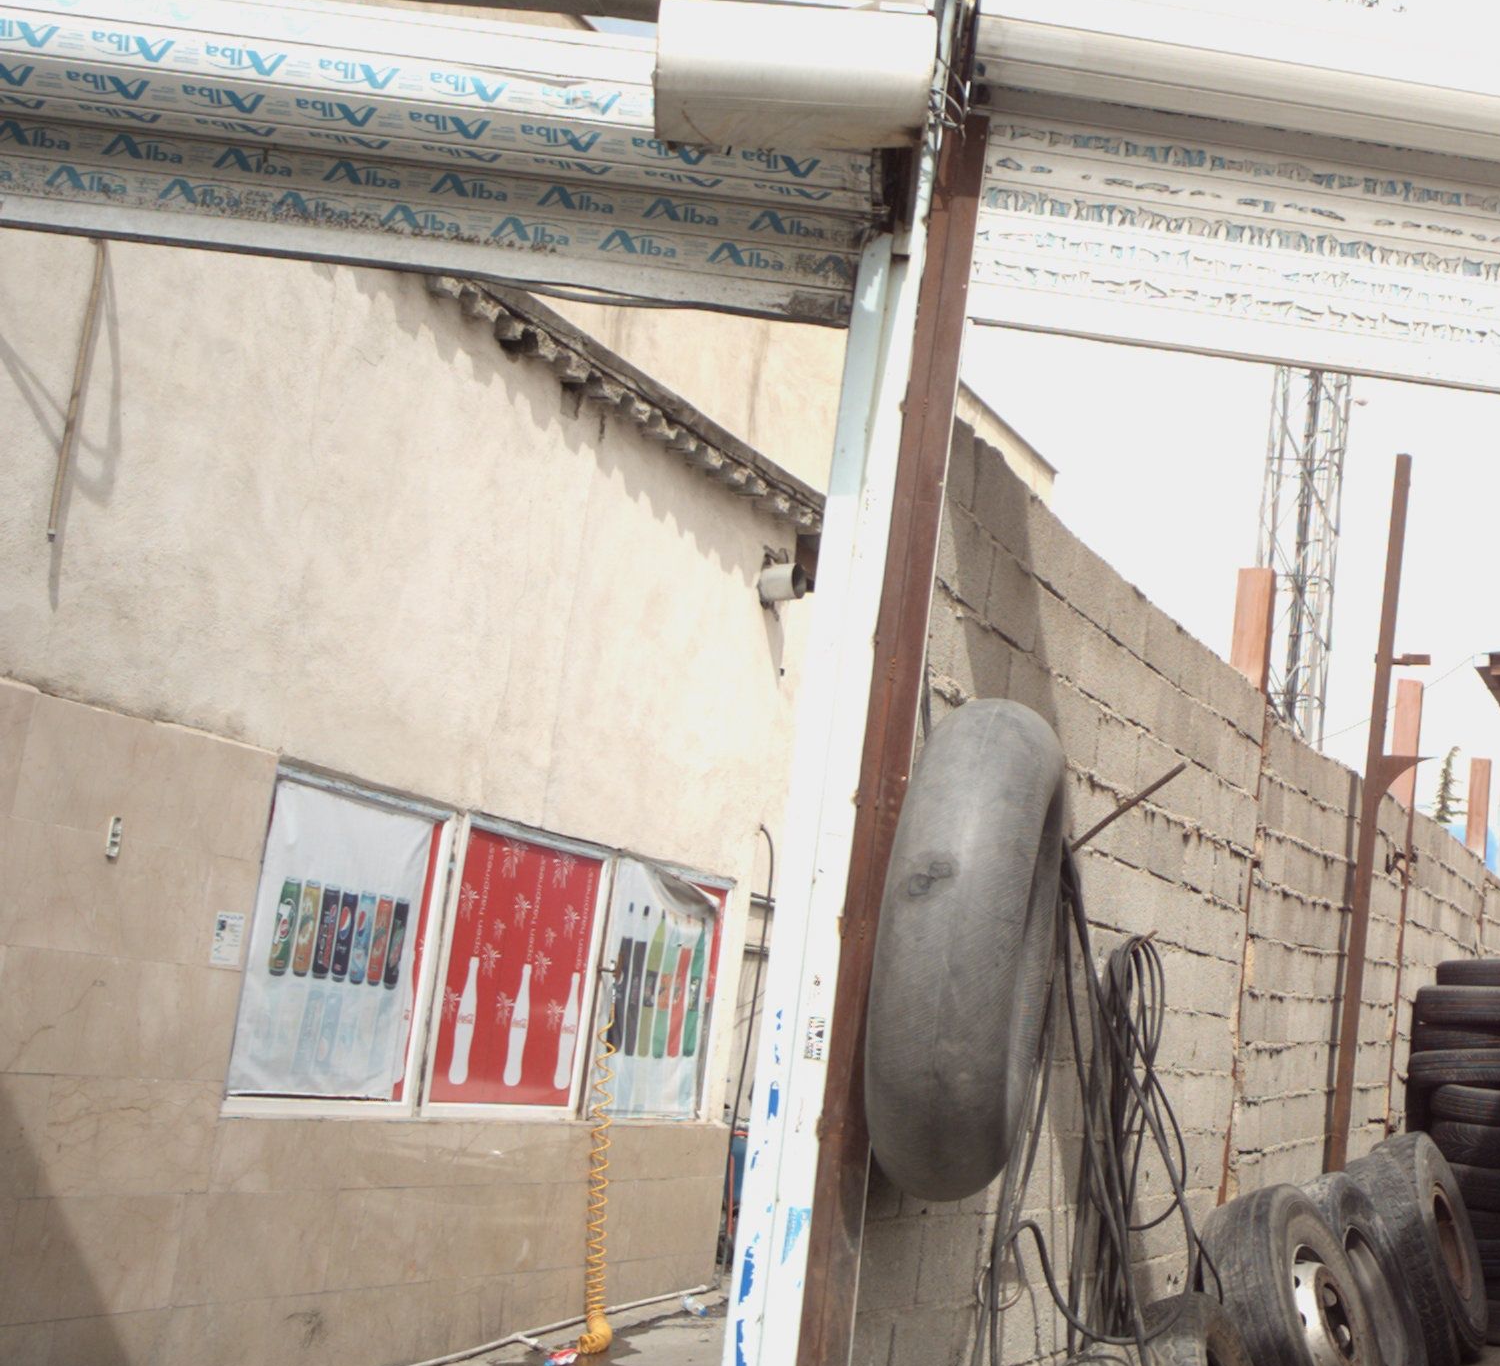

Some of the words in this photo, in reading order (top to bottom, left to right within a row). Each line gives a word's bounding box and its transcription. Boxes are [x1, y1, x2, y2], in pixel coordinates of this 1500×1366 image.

[92, 30, 175, 62] Alba
[206, 43, 287, 76] Alba
[66, 70, 151, 100] Alba
[319, 58, 400, 89] Alba
[430, 72, 508, 103] Alba
[182, 84, 265, 113] Alba
[295, 98, 378, 127] Alba
[409, 111, 491, 140] Alba
[520, 124, 602, 152] Alba
[0, 120, 70, 151] Alba
[102, 133, 183, 164] Alba
[322, 160, 400, 189] Alba
[430, 172, 508, 202] Alba
[537, 185, 614, 214] Alba
[643, 198, 719, 226] Alba
[742, 149, 821, 178] Alba
[46, 165, 127, 195] Alba
[160, 178, 241, 208] Alba
[380, 204, 461, 232] Alba
[491, 216, 570, 246] Alba
[599, 229, 676, 258] Alba
[707, 242, 785, 271] Alba
